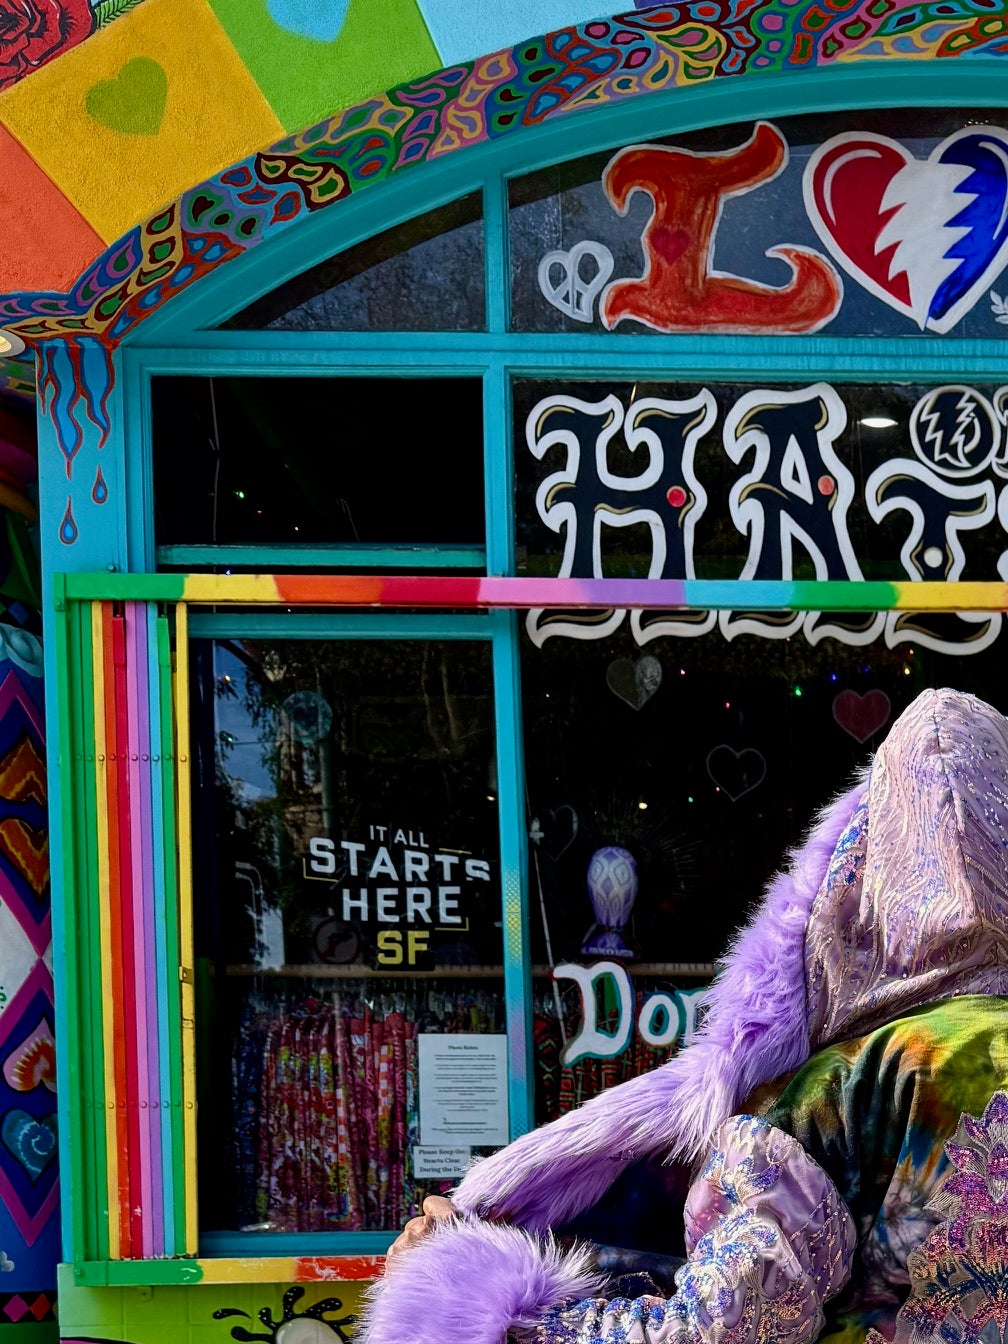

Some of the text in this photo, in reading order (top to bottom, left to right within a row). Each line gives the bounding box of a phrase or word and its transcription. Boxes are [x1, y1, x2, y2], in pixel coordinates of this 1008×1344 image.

[370, 825, 429, 848] IT ALL
[309, 837, 491, 882] STARTS
[342, 886, 462, 923] HERE
[377, 930, 430, 965] SF
